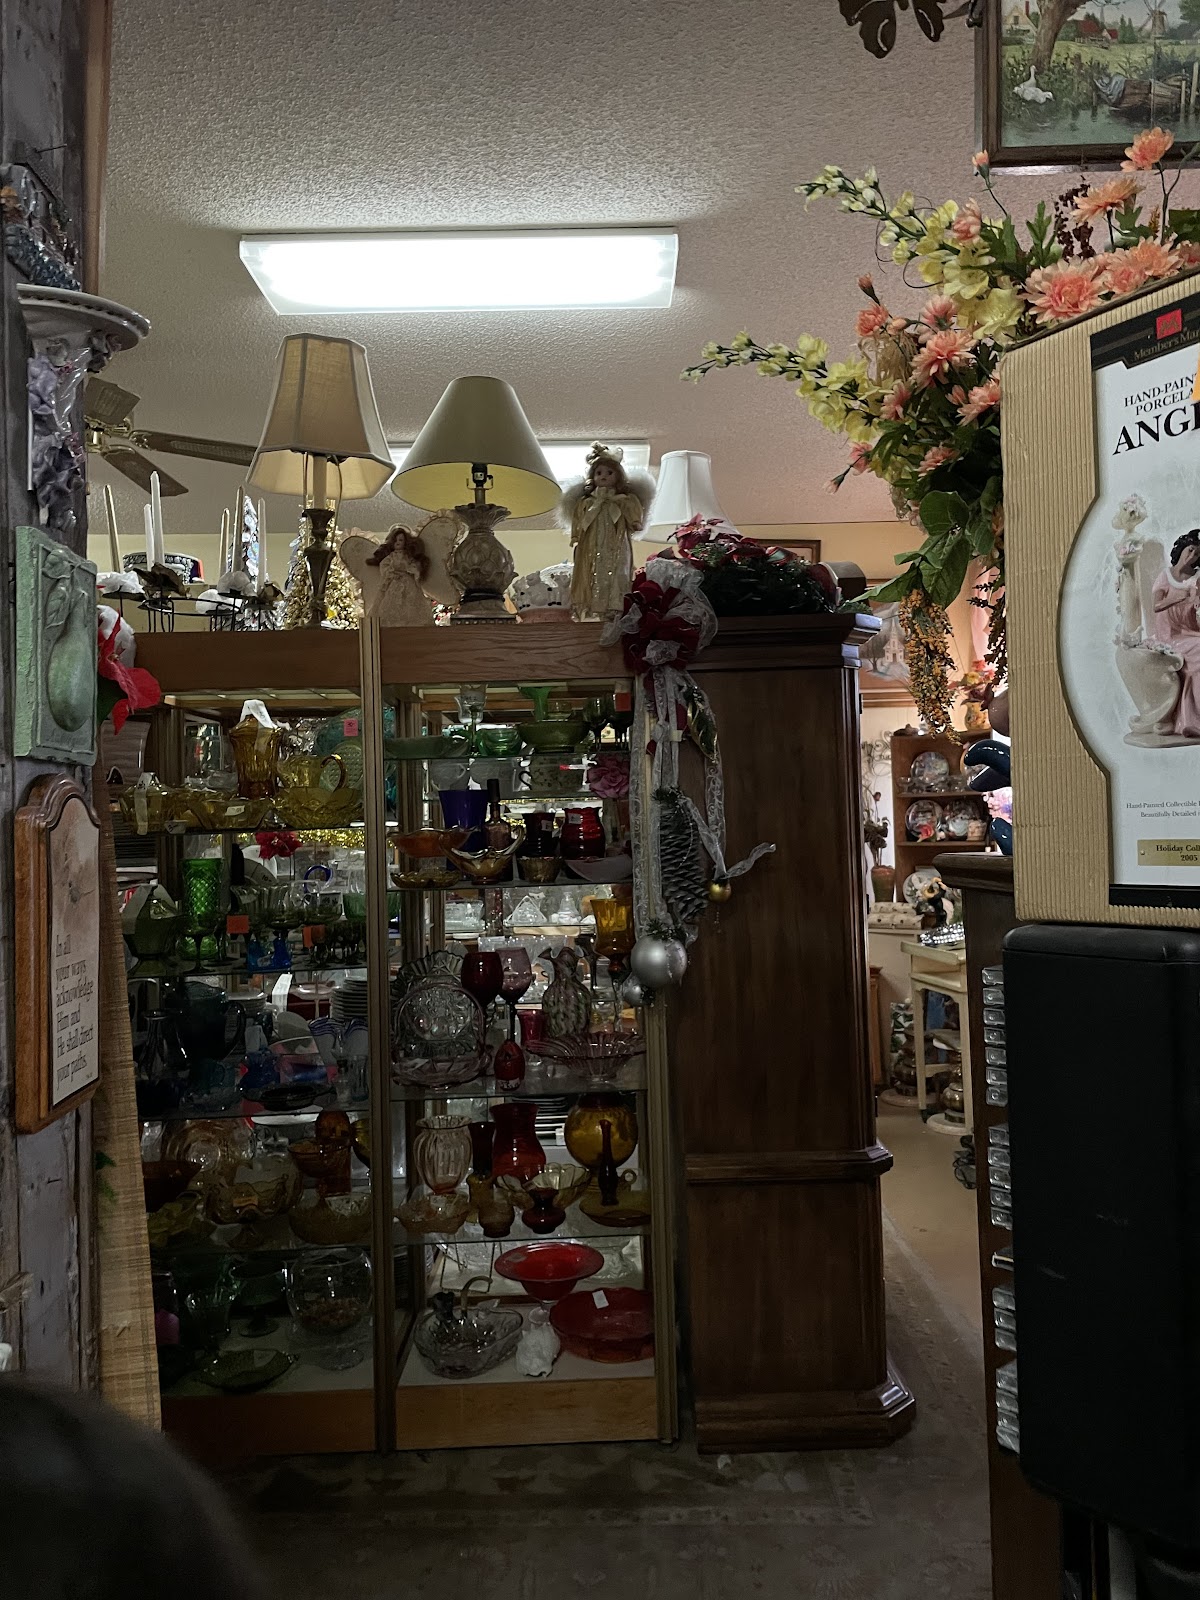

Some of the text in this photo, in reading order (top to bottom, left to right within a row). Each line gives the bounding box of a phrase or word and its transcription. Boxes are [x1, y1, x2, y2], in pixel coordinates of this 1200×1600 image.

[1124, 373, 1197, 407] HAND-PAIN
[1156, 845, 1184, 854] Holiday
[56, 934, 71, 957] In all
[56, 960, 87, 990] your ways
[56, 976, 94, 1007] acknowledge
[57, 1003, 81, 1033] Him and
[57, 1024, 94, 1058] He shall direct
[56, 1064, 70, 1090] your
